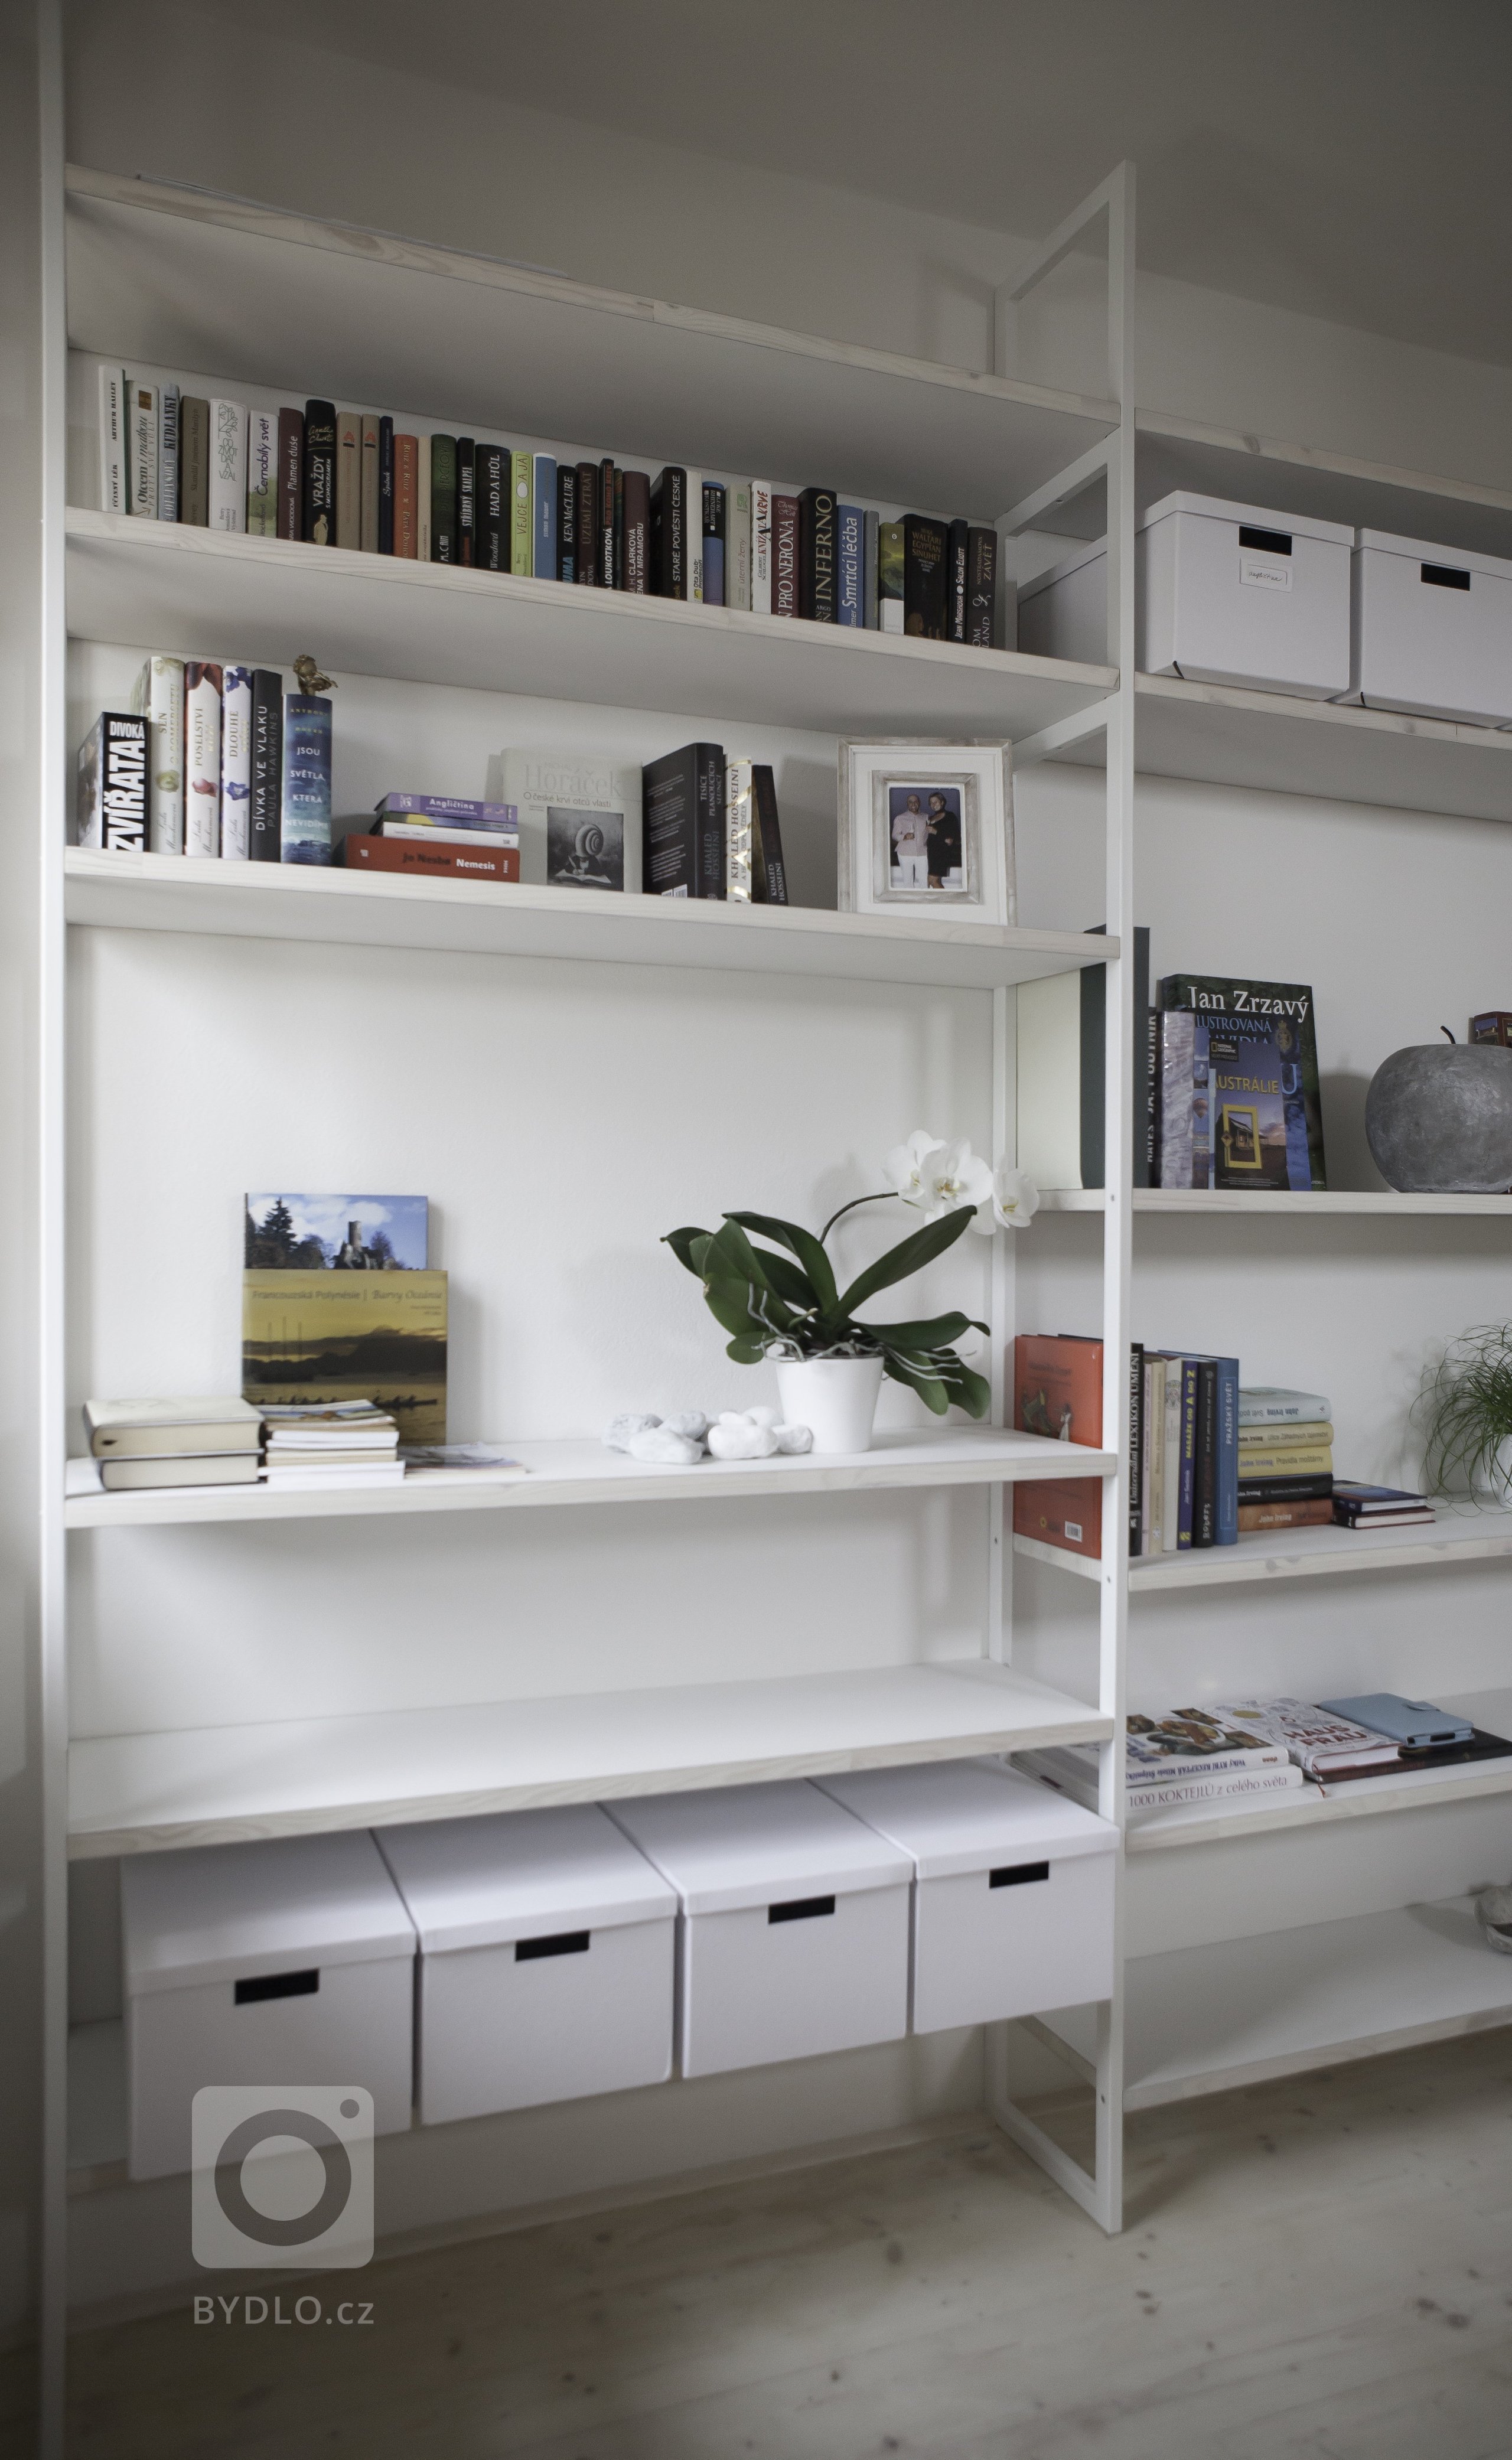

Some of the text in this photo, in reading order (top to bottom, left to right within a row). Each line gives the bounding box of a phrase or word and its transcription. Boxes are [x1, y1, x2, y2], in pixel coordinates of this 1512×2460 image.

[164, 395, 177, 450] KUDLANKY
[136, 416, 148, 503] Otcem matkou
[254, 418, 272, 496] Černobílý svět
[287, 436, 298, 491] Plamen duše
[310, 455, 325, 507] VRAŽDY
[462, 467, 472, 493] SKALPEL
[488, 455, 500, 517] HAD A HŮL
[461, 496, 472, 527] STŘÍBRNÝ
[517, 503, 527, 535] VEJCE
[563, 475, 573, 543] KEN McCLURE
[581, 471, 591, 545] ÚZEMÍ ZTRÁT
[757, 490, 768, 515] KRVE
[672, 475, 680, 582] STARÉ POVĚSTI ČESKÉ
[842, 516, 858, 555] léčba
[912, 531, 942, 546] WALTARI
[490, 532, 499, 569] Woodová
[603, 527, 612, 584] LOUKOTKOVÁ
[627, 529, 637, 576] CLARKOVÁ
[738, 538, 747, 558] ženy
[778, 520, 794, 610] PRO NERONA
[815, 494, 832, 602] INFERNO
[912, 548, 941, 562] SINUHET
[956, 548, 965, 585] SALON ELIOTT
[842, 555, 858, 608] Smrtící
[954, 595, 964, 639] JEAN MARSHOVÁ
[110, 721, 145, 739] DIVOKÁ
[158, 712, 167, 734] SEN
[194, 708, 203, 767] POSELSTVÍ
[229, 711, 239, 757] DLOUHÉ
[253, 706, 268, 831] DÍVKA VE VLAKU
[267, 712, 278, 827] PAULA HAWKINS
[296, 746, 321, 757] JSOU
[103, 739, 145, 852] ZVÍŘATA
[524, 763, 621, 797] Horáček
[731, 768, 739, 827] HOSSEINI
[429, 798, 475, 810] Angličtina
[523, 791, 612, 808] O české krvi otců vlasti
[456, 858, 496, 871] Nemesis
[704, 833, 712, 875] KHALED
[712, 830, 721, 879] HOSSEINI
[768, 864, 778, 897] KHALED
[775, 862, 786, 902] HOSSEINI
[1187, 986, 1309, 1024] Jan Zrzavý
[1197, 1014, 1273, 1033] LUSTROVANÁ
[372, 1289, 403, 1304] Barvy
[1187, 1370, 1195, 1378] Z
[1129, 1395, 1139, 1448] LEXIKON
[1224, 1381, 1233, 1445] PRAŽSKÝ SVĚT
[1266, 1408, 1283, 1416] Irving
[1255, 1458, 1273, 1467] Irving
[1276, 1456, 1298, 1465] Pravidla
[1282, 1724, 1350, 1739] HAUS
[1299, 1731, 1367, 1746] FRAU
[1177, 1763, 1211, 1775] RECEPTÁŘ
[1212, 1760, 1227, 1771] RYBÍ
[1229, 1759, 1246, 1768] Velký
[1129, 1775, 1288, 1807] 1000 KOKTEJLŮ z celého světa
